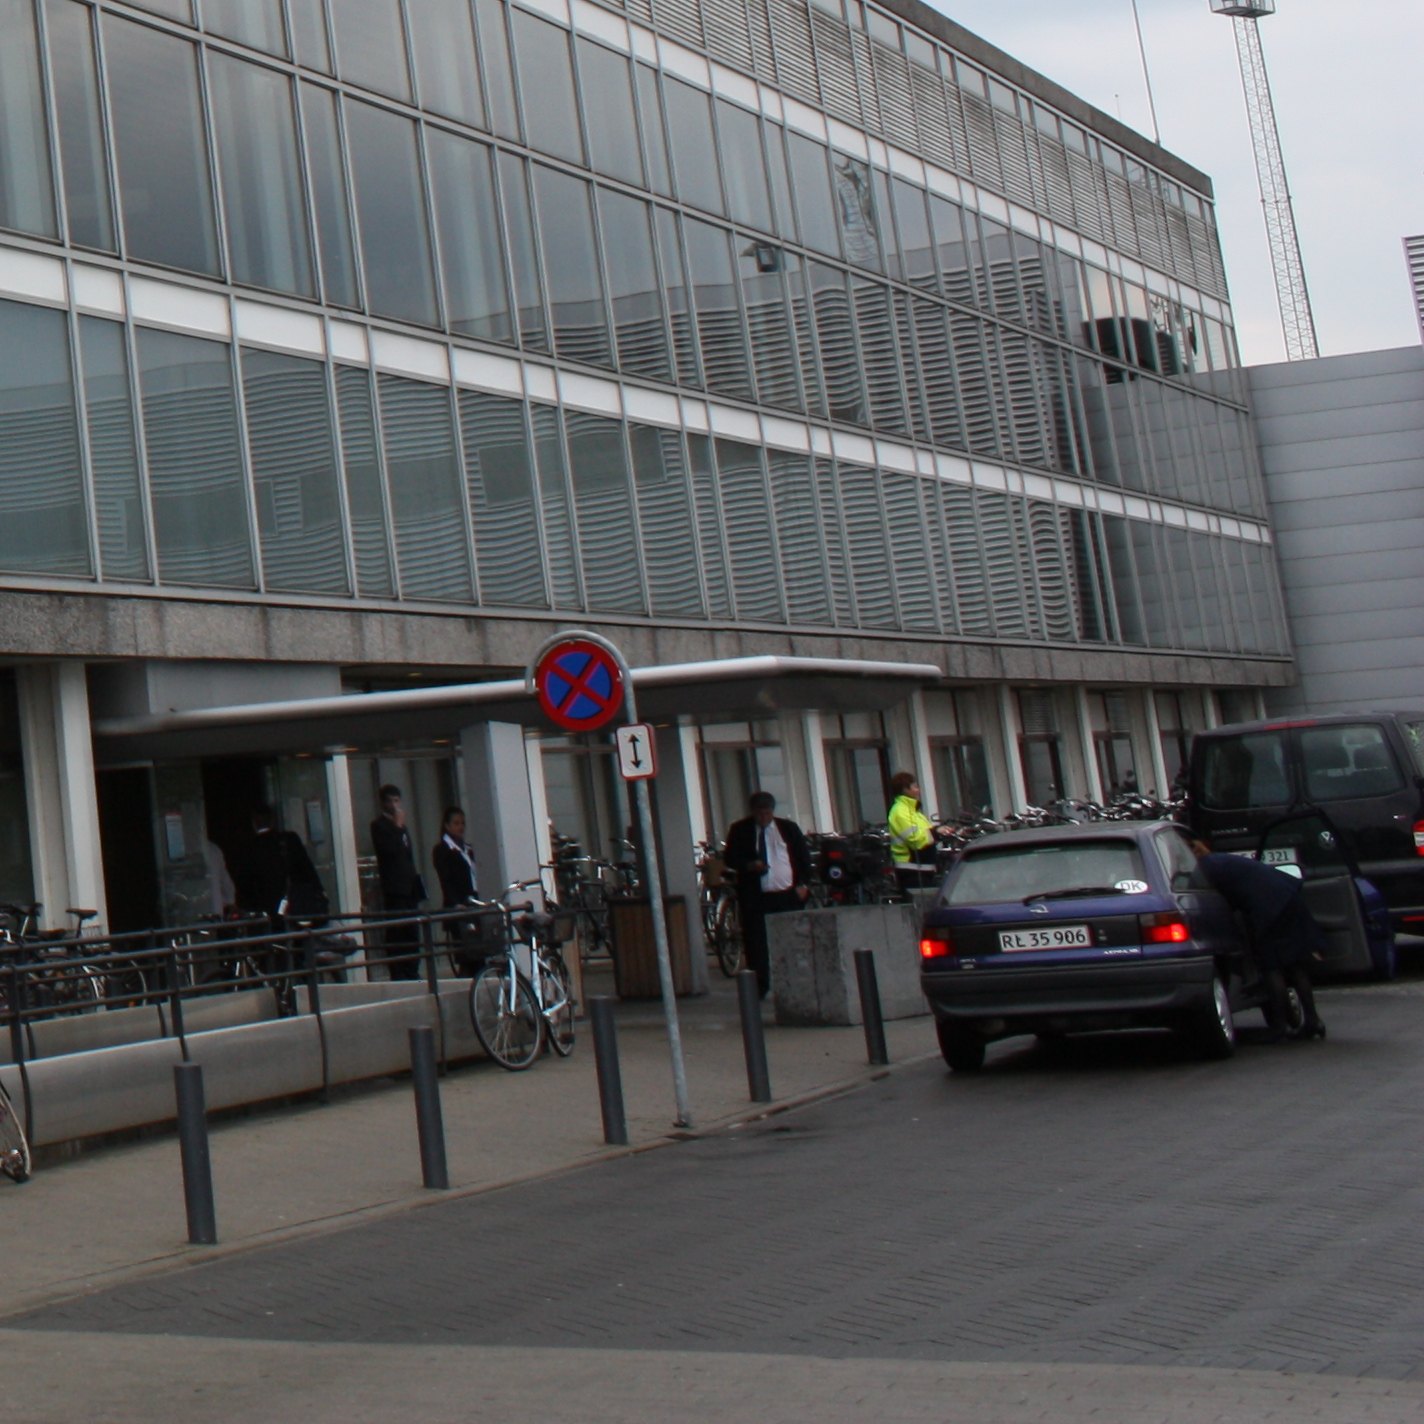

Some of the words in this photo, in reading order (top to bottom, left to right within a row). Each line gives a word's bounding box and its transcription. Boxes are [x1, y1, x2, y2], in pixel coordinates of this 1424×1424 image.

[1268, 850, 1289, 862] 321
[1120, 881, 1142, 891] DK
[1002, 934, 1026, 949] RL
[1029, 932, 1051, 947] 35
[1053, 929, 1086, 945] 906
